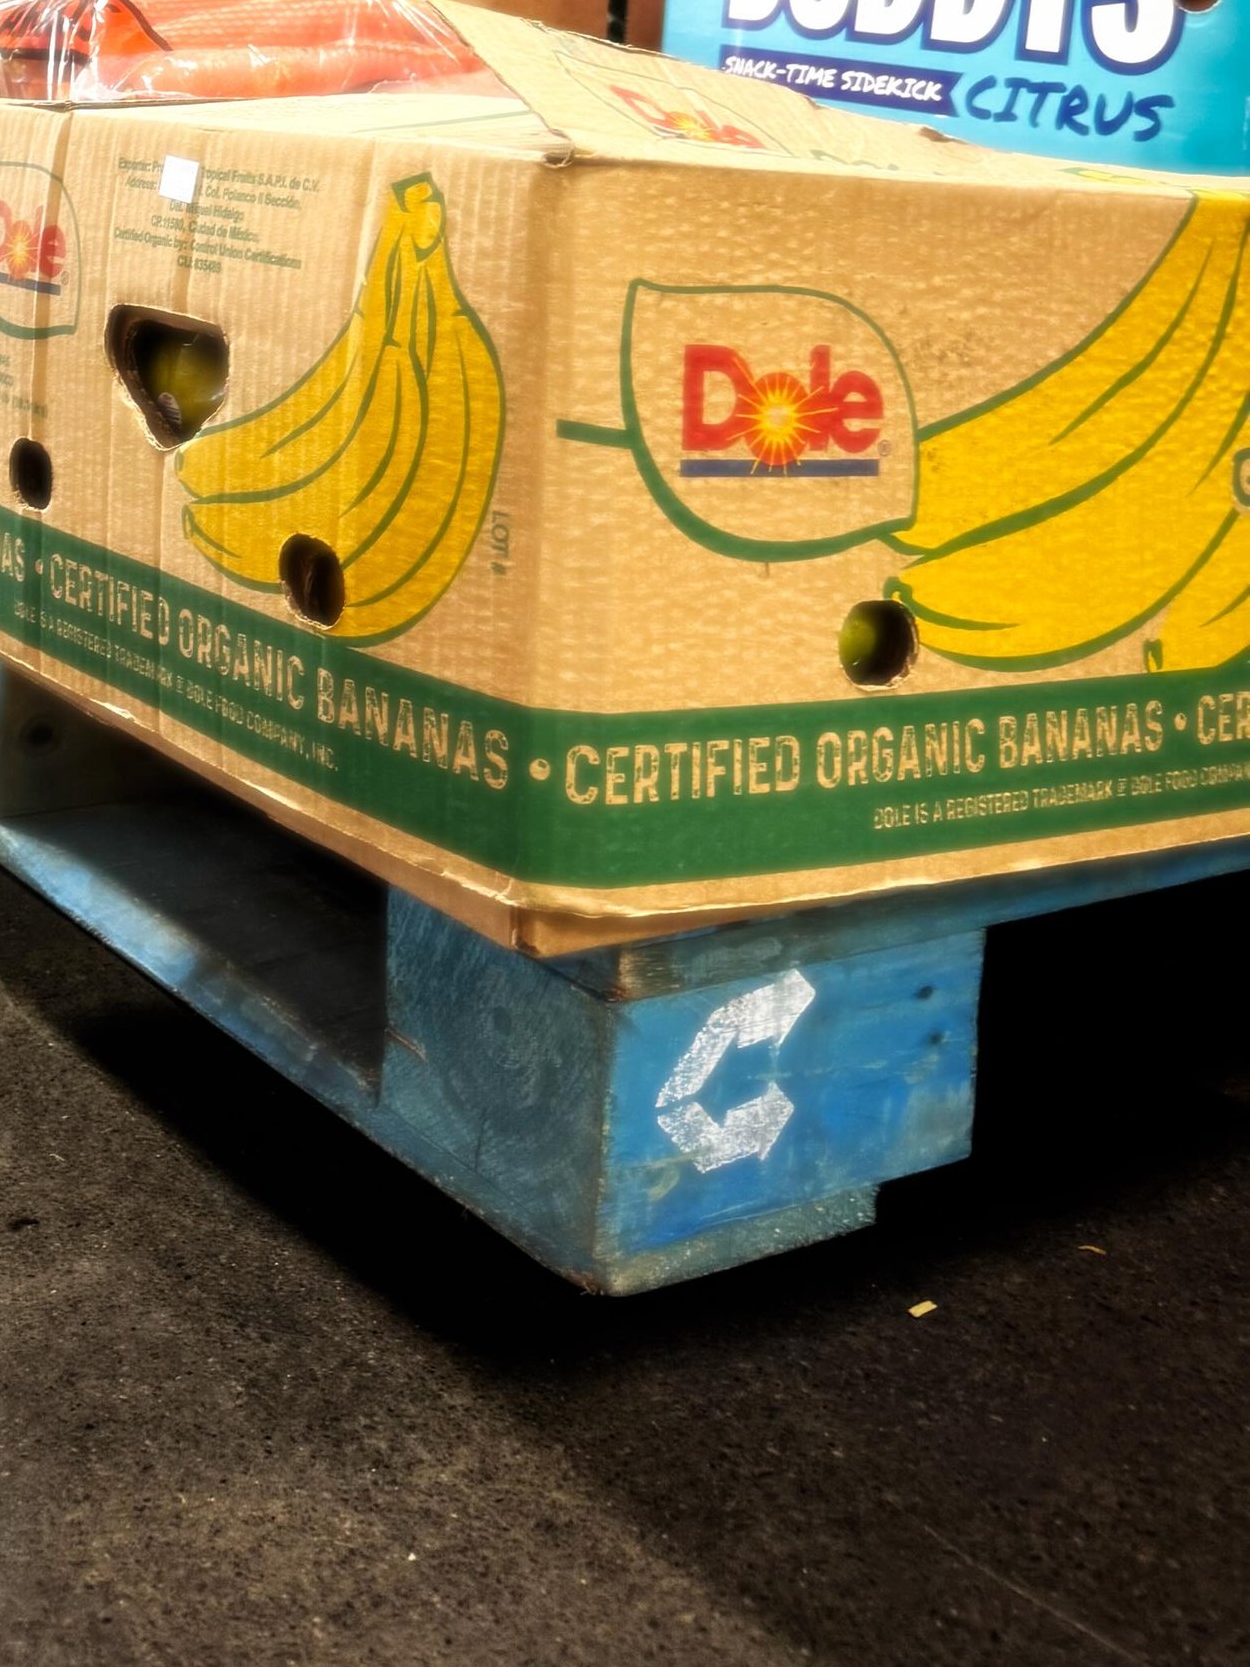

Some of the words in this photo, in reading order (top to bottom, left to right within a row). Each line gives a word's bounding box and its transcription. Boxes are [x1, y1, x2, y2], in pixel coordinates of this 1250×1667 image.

[724, 55, 837, 88] SNACK-TIME
[841, 70, 942, 101] SIDEKICK
[966, 74, 1174, 141] CITRUS
[681, 344, 884, 466] Dole
[491, 510, 510, 559] LOT
[49, 552, 170, 646] CERTIFIED
[178, 608, 306, 712] ORGANIC
[316, 667, 510, 790] BANANAS
[565, 734, 800, 806] CERTIFIED
[816, 717, 985, 790] ORGANIC
[998, 700, 1164, 770] BANANAS
[874, 803, 910, 829] DOLE
[915, 802, 928, 825] IS
[933, 801, 943, 822] A
[947, 790, 1029, 820] REGISTERED
[1032, 780, 1112, 809] TRADEMARK
